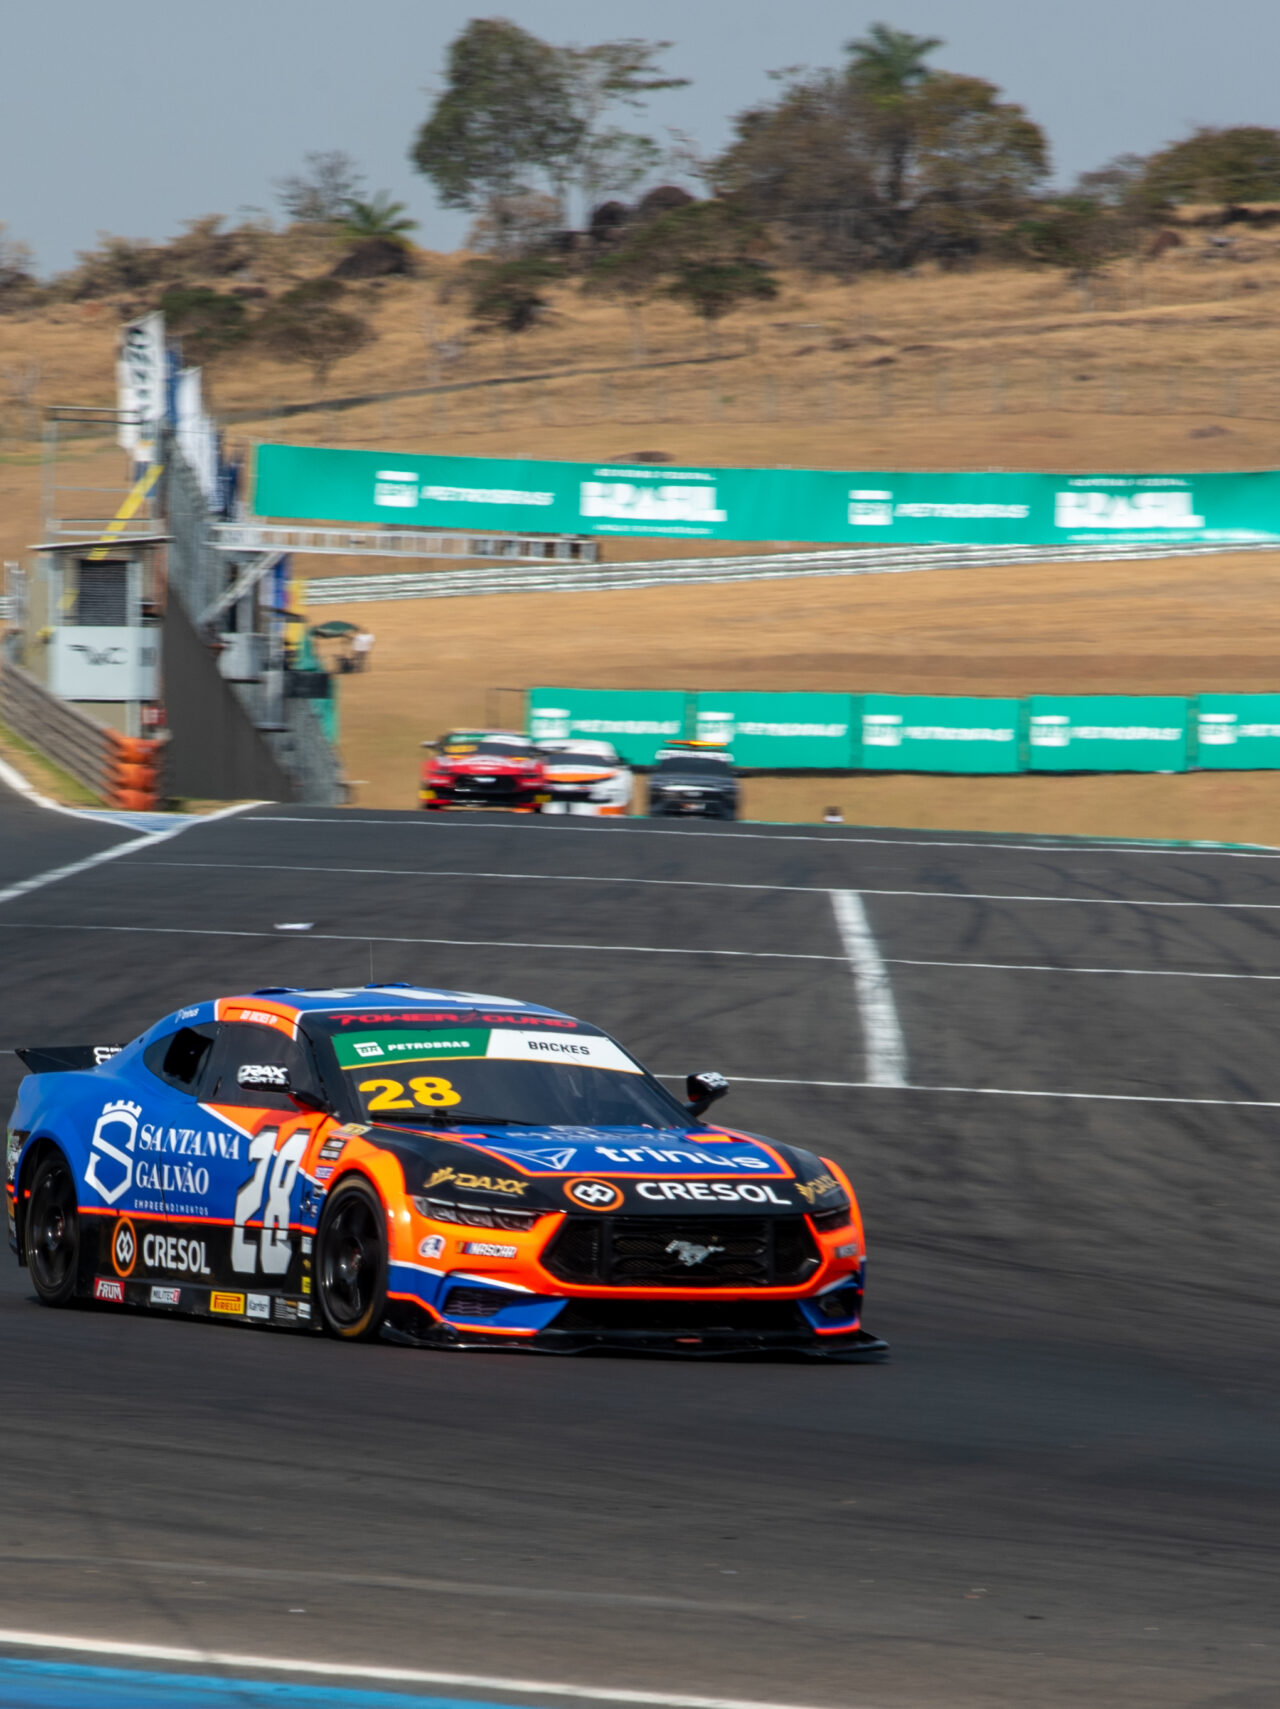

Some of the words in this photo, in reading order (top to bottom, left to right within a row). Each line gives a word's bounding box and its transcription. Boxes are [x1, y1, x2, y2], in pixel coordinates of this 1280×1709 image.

[387, 1041, 470, 1052] PETROBRAS
[528, 1040, 591, 1056] BACKES
[358, 1076, 462, 1112] 28
[139, 1123, 240, 1160] SANTANNA
[595, 1145, 770, 1169] trinus
[135, 1161, 210, 1196] GALVÃO
[453, 1172, 531, 1196] DAXX
[231, 1125, 312, 1274] 28
[634, 1181, 793, 1205] CRESOL
[134, 1198, 209, 1216] EMPREENDIMENTOS
[142, 1233, 211, 1275] CRESOL
[96, 1280, 123, 1300] FRUM
[213, 1293, 243, 1312] PIRELLI
